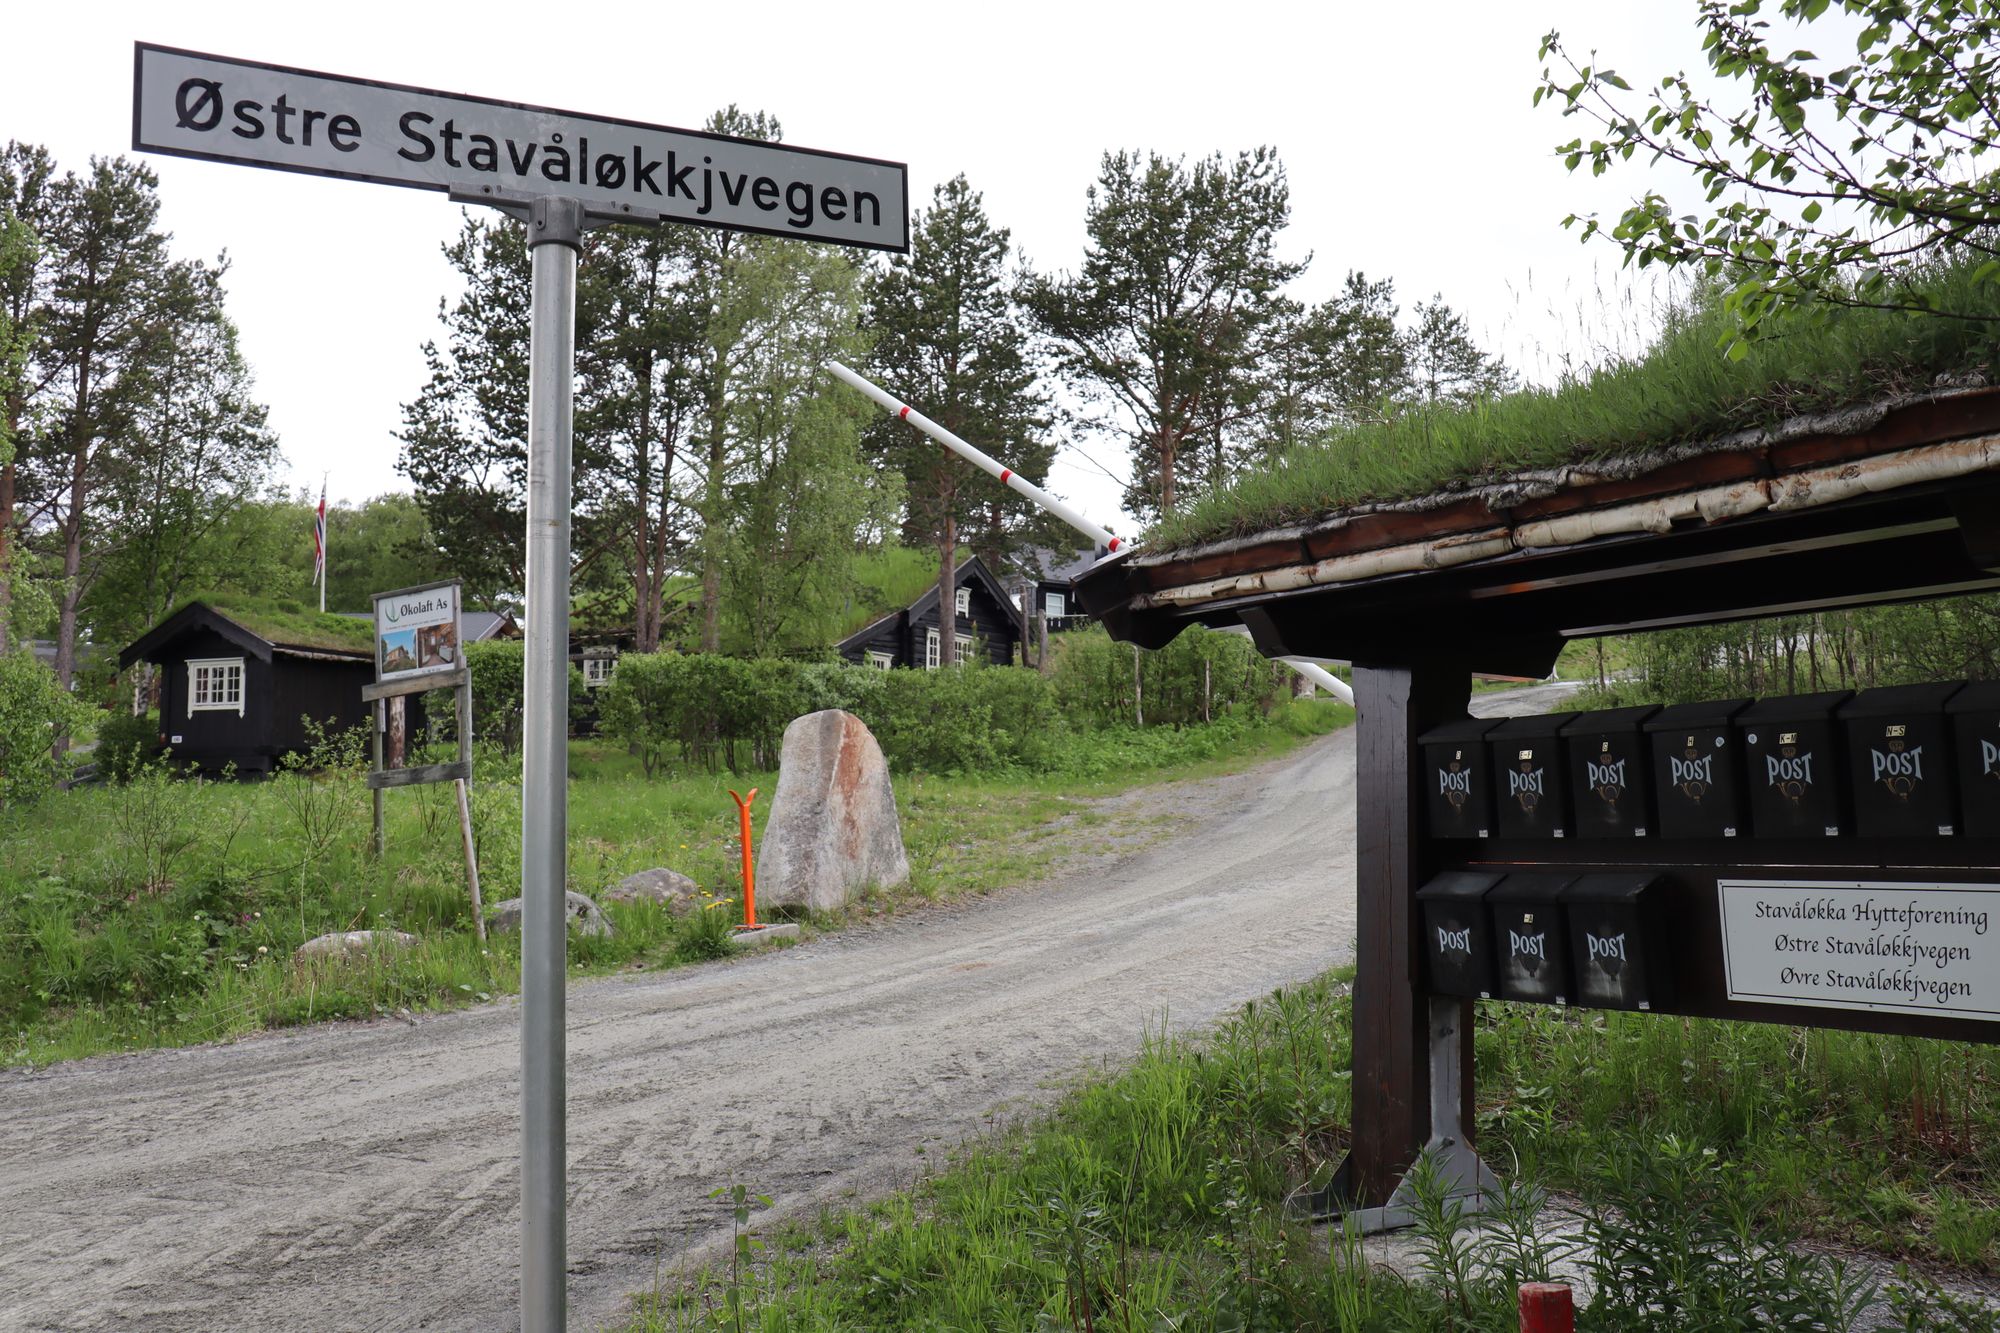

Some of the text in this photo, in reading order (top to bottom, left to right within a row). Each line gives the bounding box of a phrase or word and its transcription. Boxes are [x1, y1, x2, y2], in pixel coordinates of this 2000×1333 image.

[175, 77, 881, 229] Østre Stavåløkkjvegen
[400, 598, 448, 617] Økolaft As
[1780, 733, 1797, 744] K-M
[1886, 726, 1905, 736] N-S
[1587, 759, 1625, 790] POST
[1670, 755, 1712, 786] POST
[1766, 752, 1812, 785] POST
[1871, 746, 1923, 782] POST
[1439, 768, 1471, 795] POST
[1508, 768, 1543, 796] POST
[1755, 898, 1988, 935] Stavåløkka Hytteforening
[1437, 926, 1471, 954] POST
[1509, 929, 1545, 960] POST
[1586, 933, 1626, 962] POST
[1775, 934, 1971, 968] Østre Stavåløkkjvegen
[1780, 967, 1972, 1003] Øvre Stavåløkkjvegen
